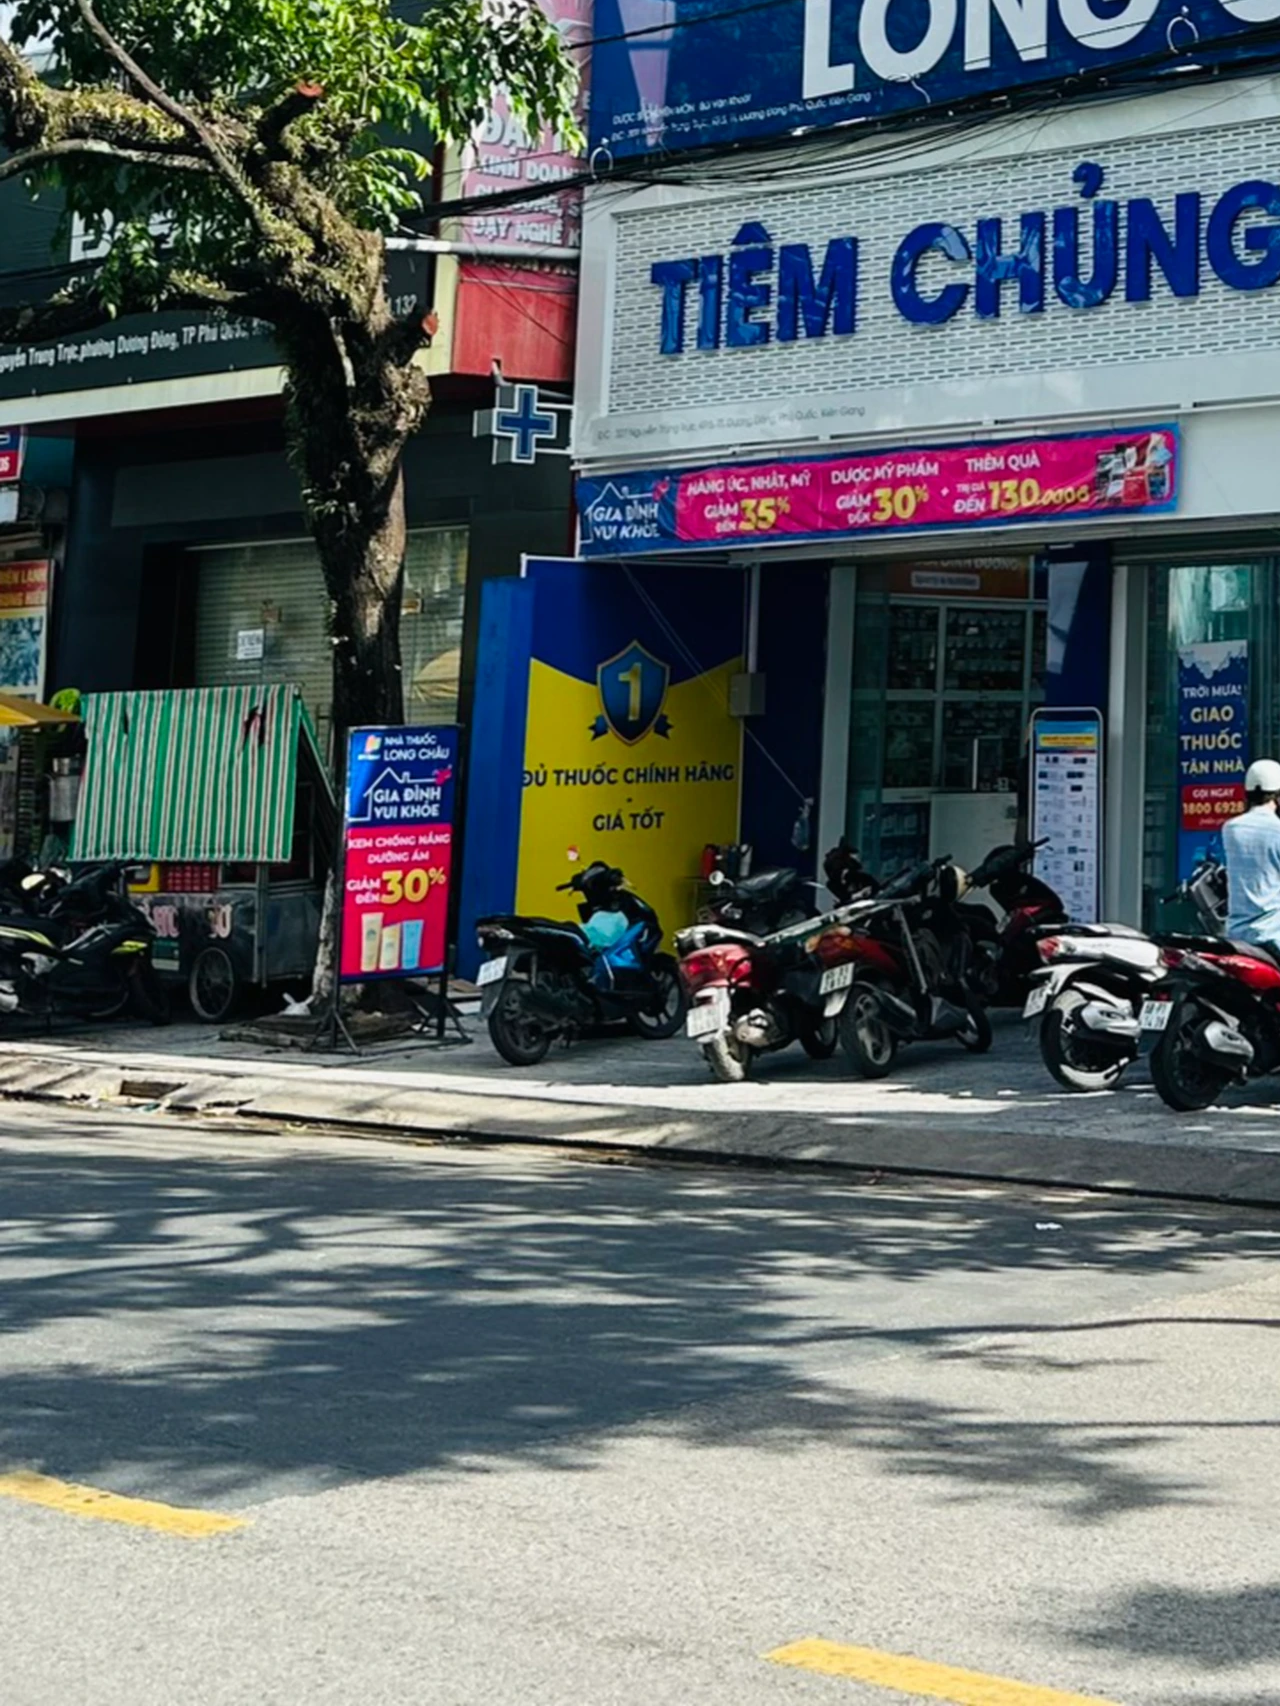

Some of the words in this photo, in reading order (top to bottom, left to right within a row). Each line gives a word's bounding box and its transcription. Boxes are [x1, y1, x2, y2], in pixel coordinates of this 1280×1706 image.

[651, 221, 860, 357] TIÊM
[966, 454, 1005, 473] THÊM
[1007, 449, 1041, 470] QUÀ
[831, 469, 871, 484] DƯỢC
[1190, 704, 1234, 723] GIAO
[1180, 727, 1243, 751] THUỐC
[383, 748, 416, 761] LONG
[418, 745, 450, 760] CHÂU
[553, 761, 619, 786] THUỐC
[623, 761, 680, 784] CHÍNH
[1181, 757, 1210, 777] TẬN
[1213, 755, 1245, 774] NHÀ
[373, 788, 400, 803] GIA
[403, 784, 442, 802] ĐÌNH
[373, 805, 398, 819] VUI
[400, 800, 440, 818] KHỎE
[1183, 802, 1212, 815] 1800
[1214, 800, 1245, 814] 6928
[592, 808, 625, 832] GIÁ
[629, 805, 665, 831] TỐT
